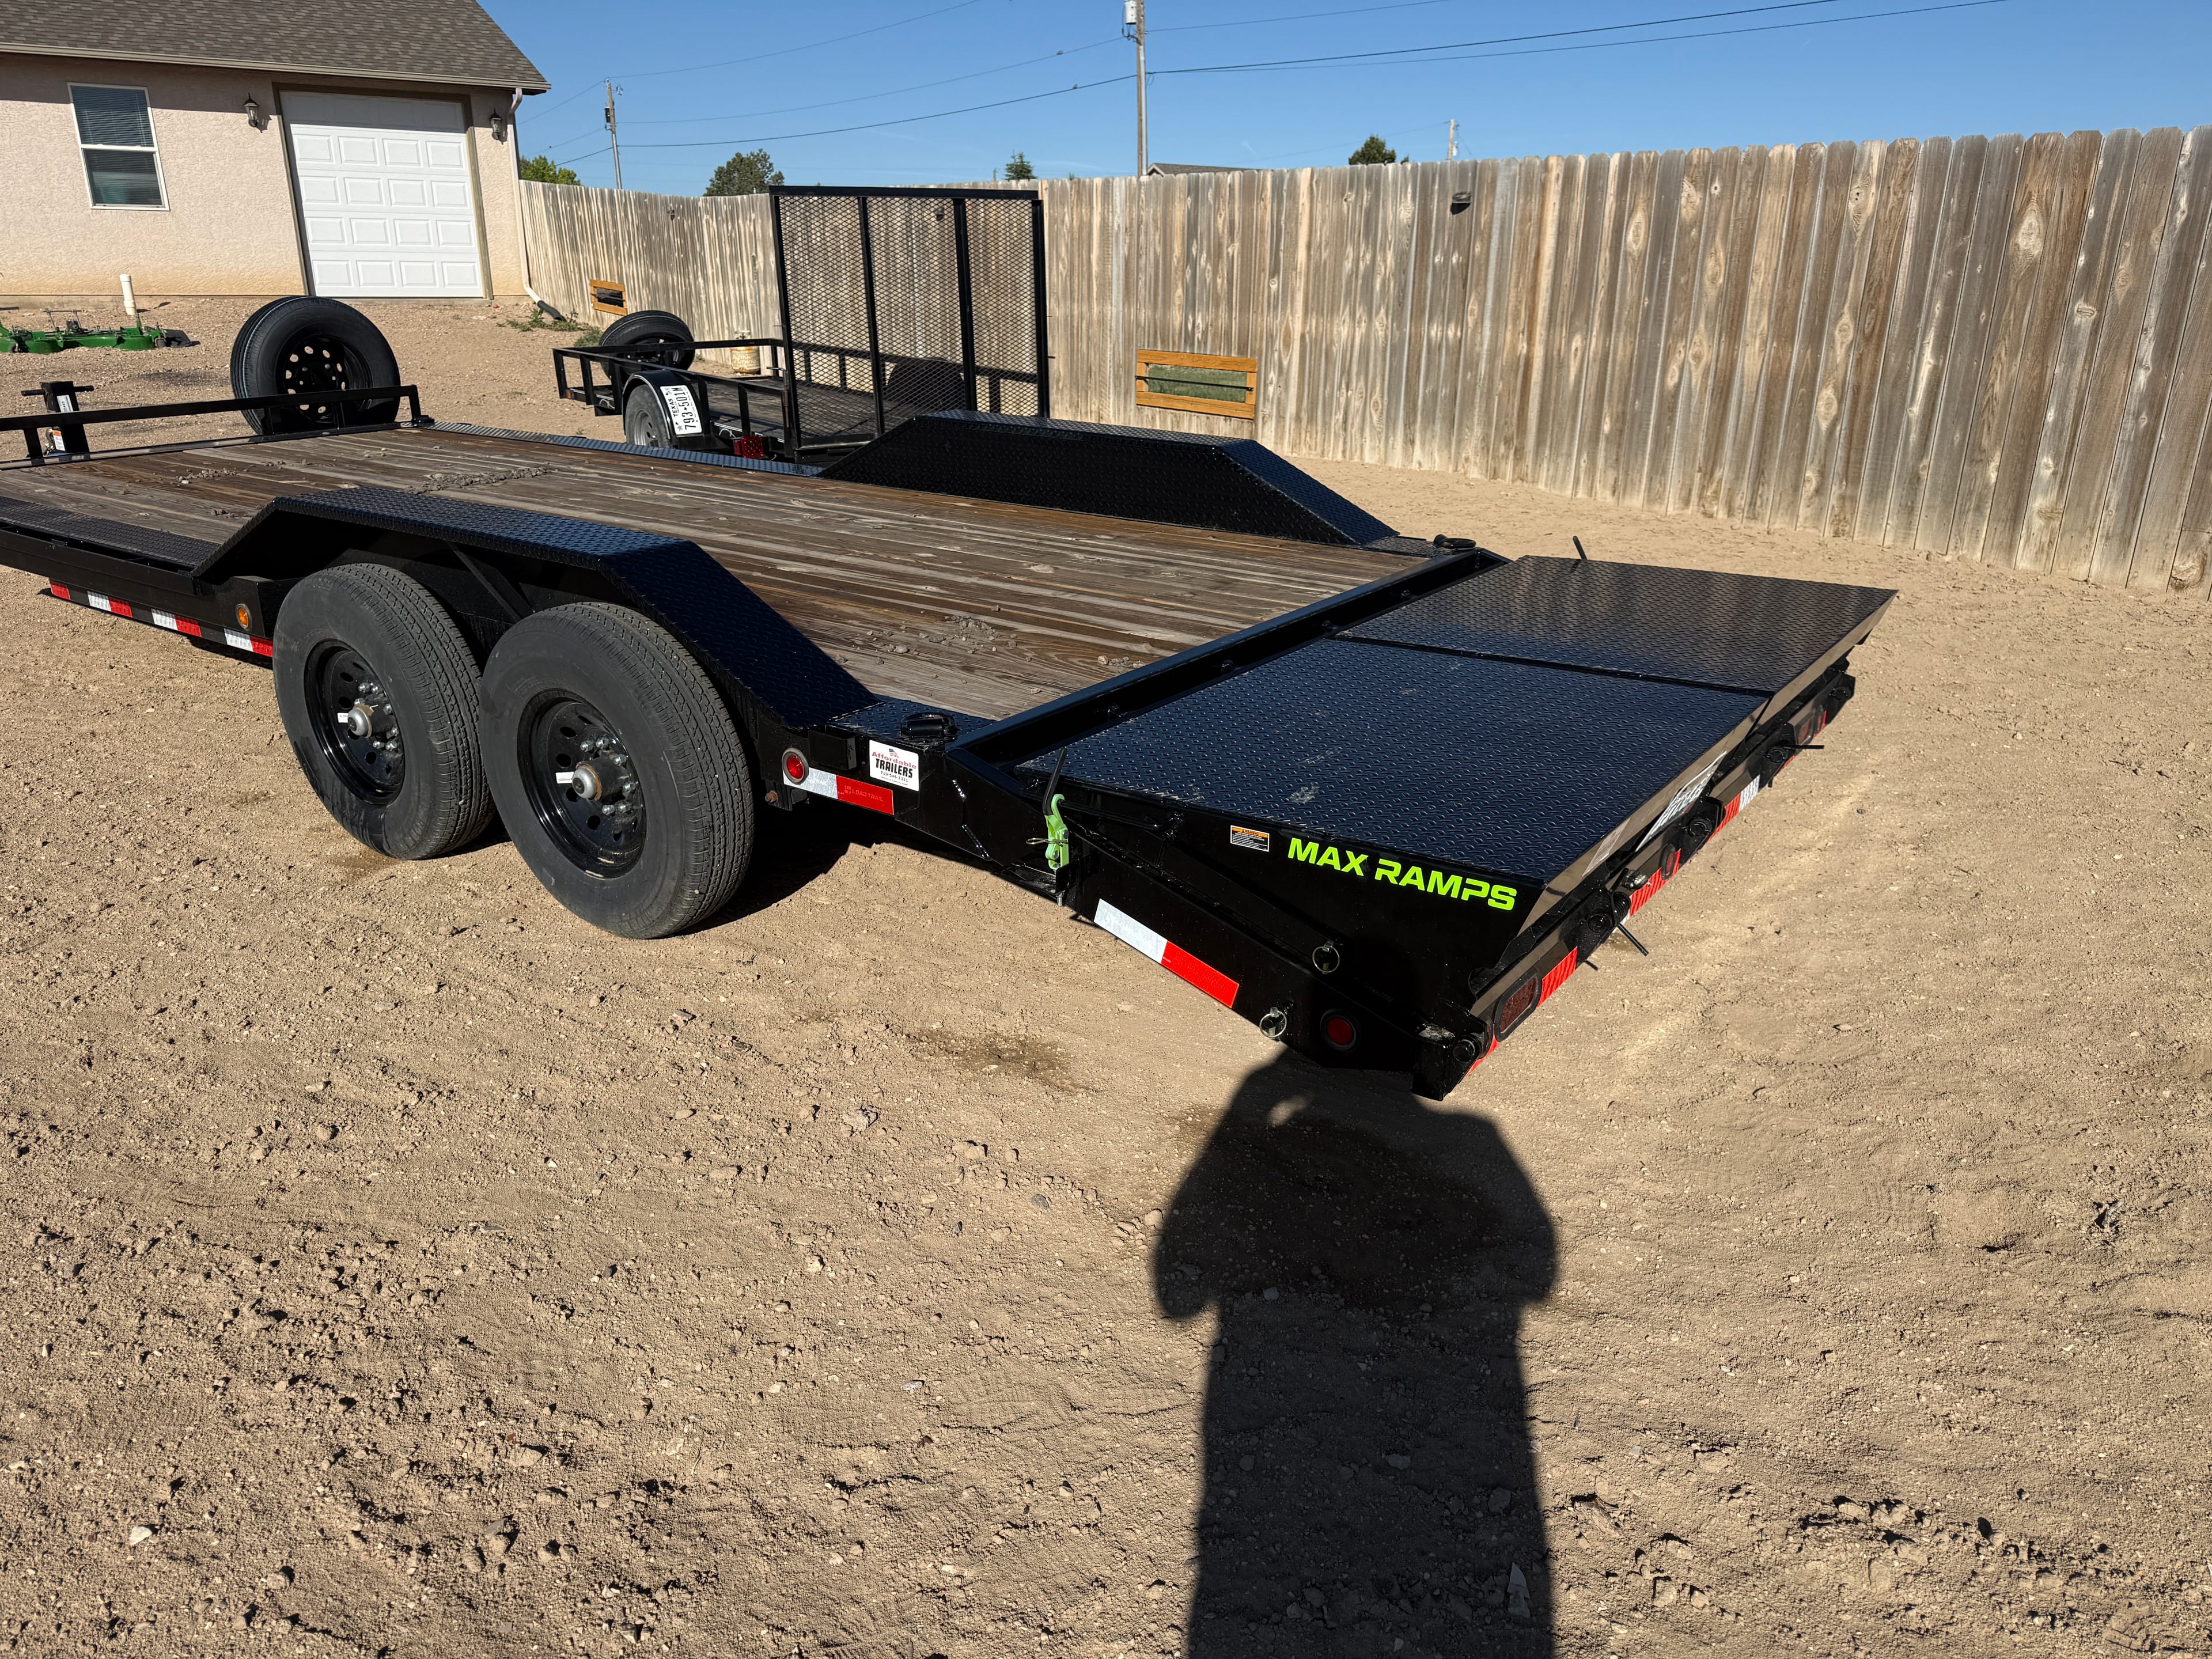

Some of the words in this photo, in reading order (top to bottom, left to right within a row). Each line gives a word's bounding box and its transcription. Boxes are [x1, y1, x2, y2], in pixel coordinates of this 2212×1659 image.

[668, 398, 678, 417] TEXAS
[872, 751, 916, 770] Affordable
[876, 758, 913, 778] TRAILERS
[852, 789, 867, 797] LOAD
[868, 793, 884, 802] TRAIL
[1287, 837, 1369, 877] MAX
[1374, 858, 1517, 911] RAMPS
